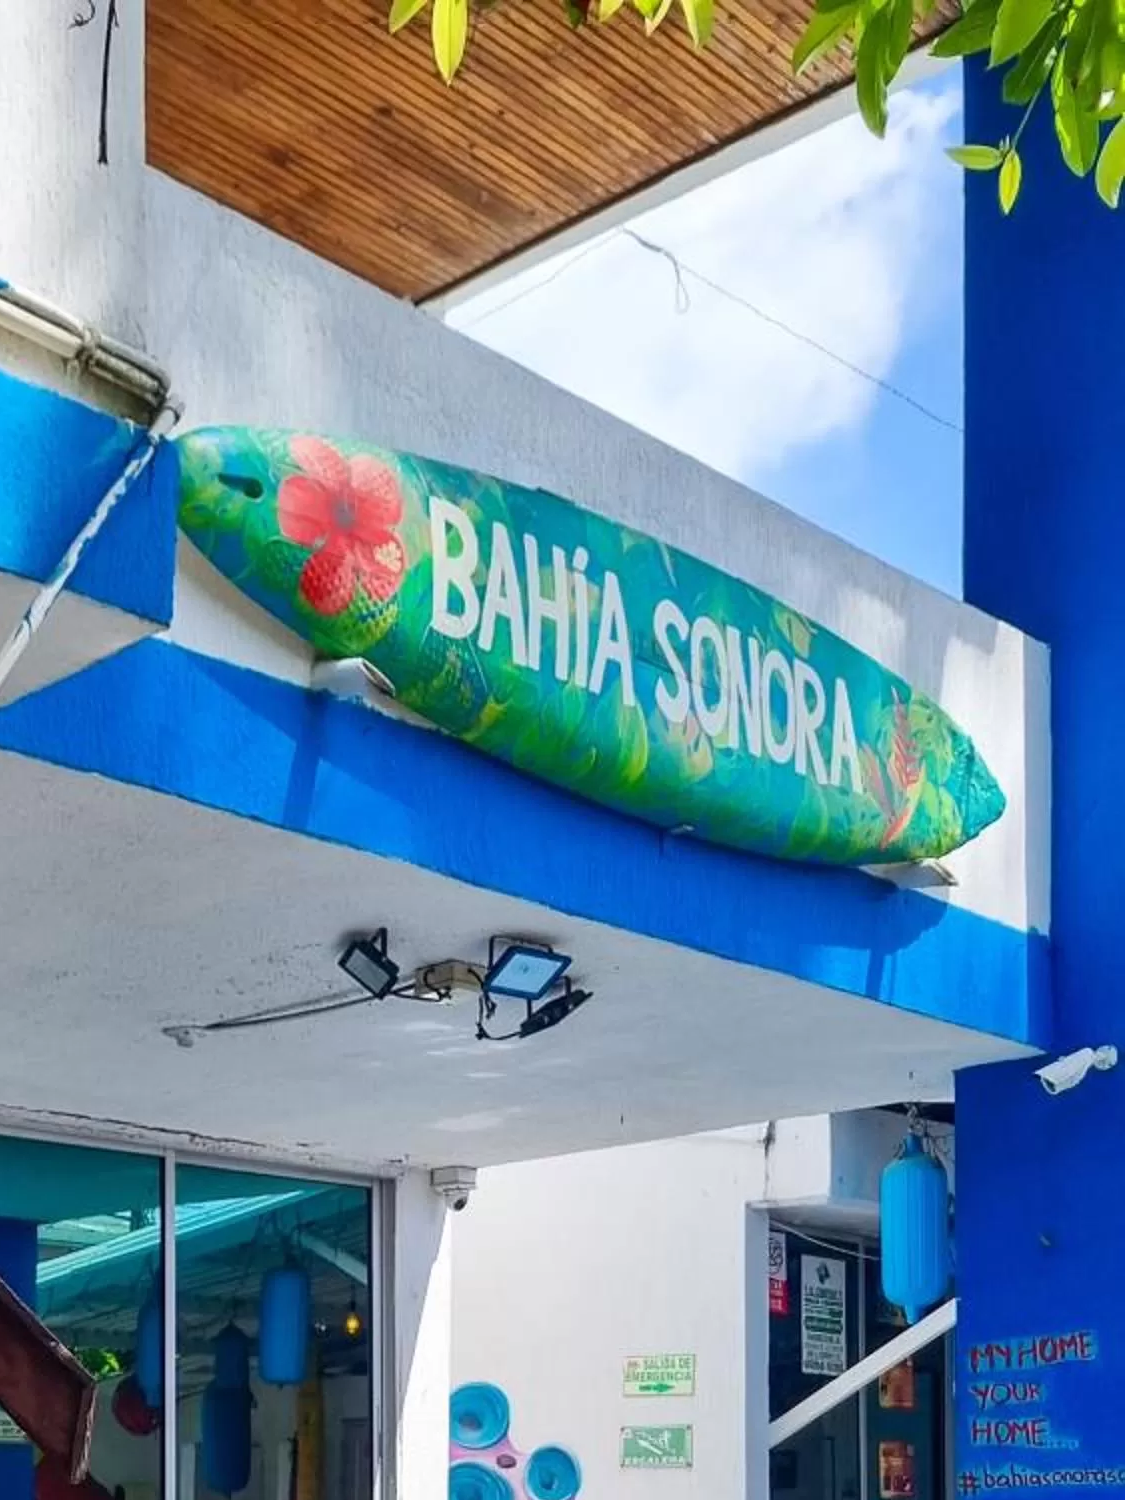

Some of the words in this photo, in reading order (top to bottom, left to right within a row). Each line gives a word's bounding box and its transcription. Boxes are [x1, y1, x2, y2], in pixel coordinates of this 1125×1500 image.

[428, 495, 635, 706] BAHÍA
[652, 597, 862, 793] SONORA
[969, 1343, 1012, 1372] MY
[1018, 1330, 1093, 1367] HOME
[970, 1382, 1041, 1410] YOUR
